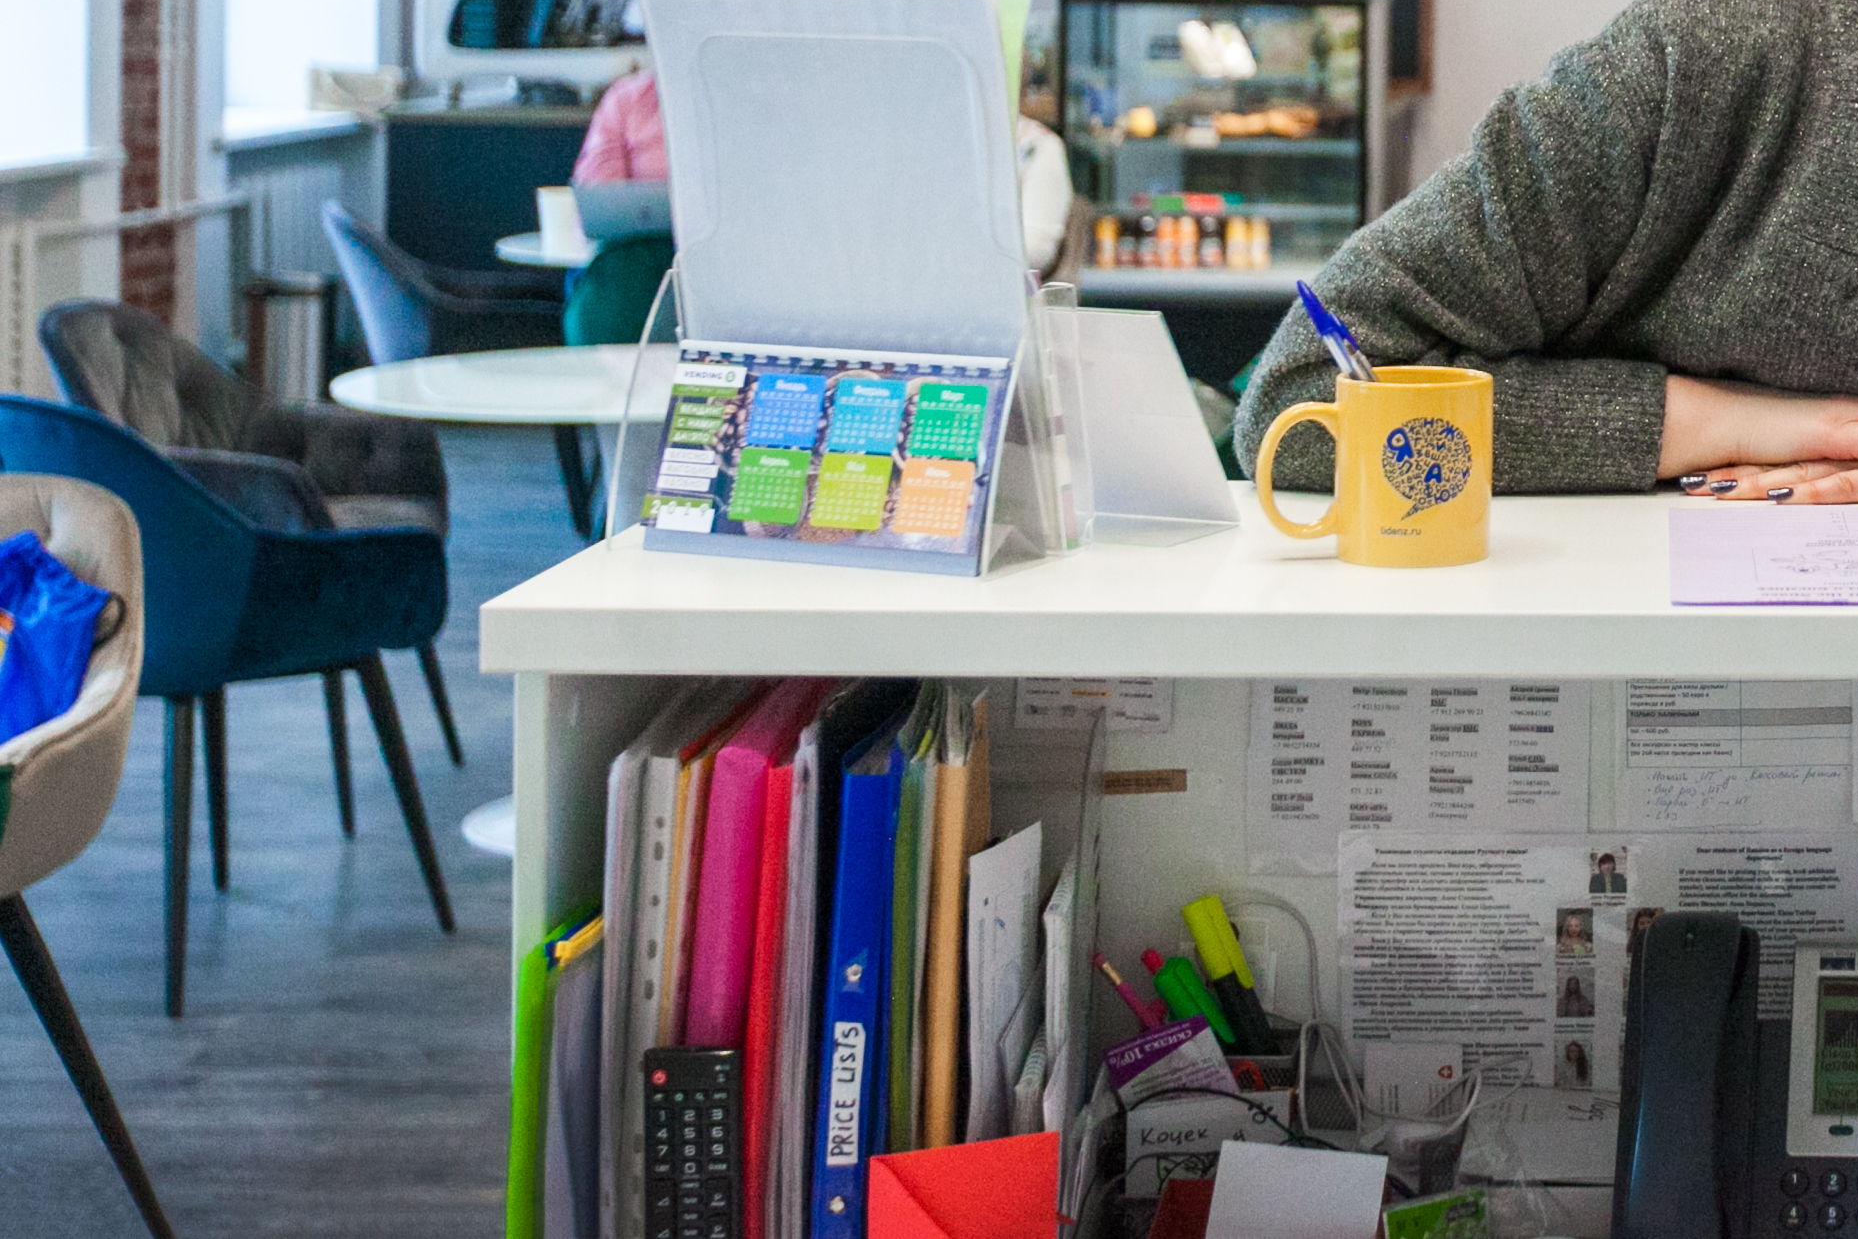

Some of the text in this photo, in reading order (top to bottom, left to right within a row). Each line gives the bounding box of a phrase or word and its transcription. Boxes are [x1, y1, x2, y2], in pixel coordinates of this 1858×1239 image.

[684, 370, 723, 381] VENDING
[1380, 525, 1421, 536] lidenz.ru
[658, 1110, 666, 1122] 1
[684, 1110, 696, 1122] 2
[711, 1108, 724, 1120] 3
[656, 1127, 669, 1140] 4
[684, 1127, 696, 1139] 5
[711, 1126, 724, 1138] 6
[656, 1144, 669, 1157] 7
[684, 1144, 696, 1157] 8
[711, 1143, 724, 1155] 9
[1791, 1173, 1798, 1184] 1
[1830, 1173, 1837, 1185] 2
[1789, 1207, 1797, 1218] 4
[1829, 1207, 1836, 1218] 5
